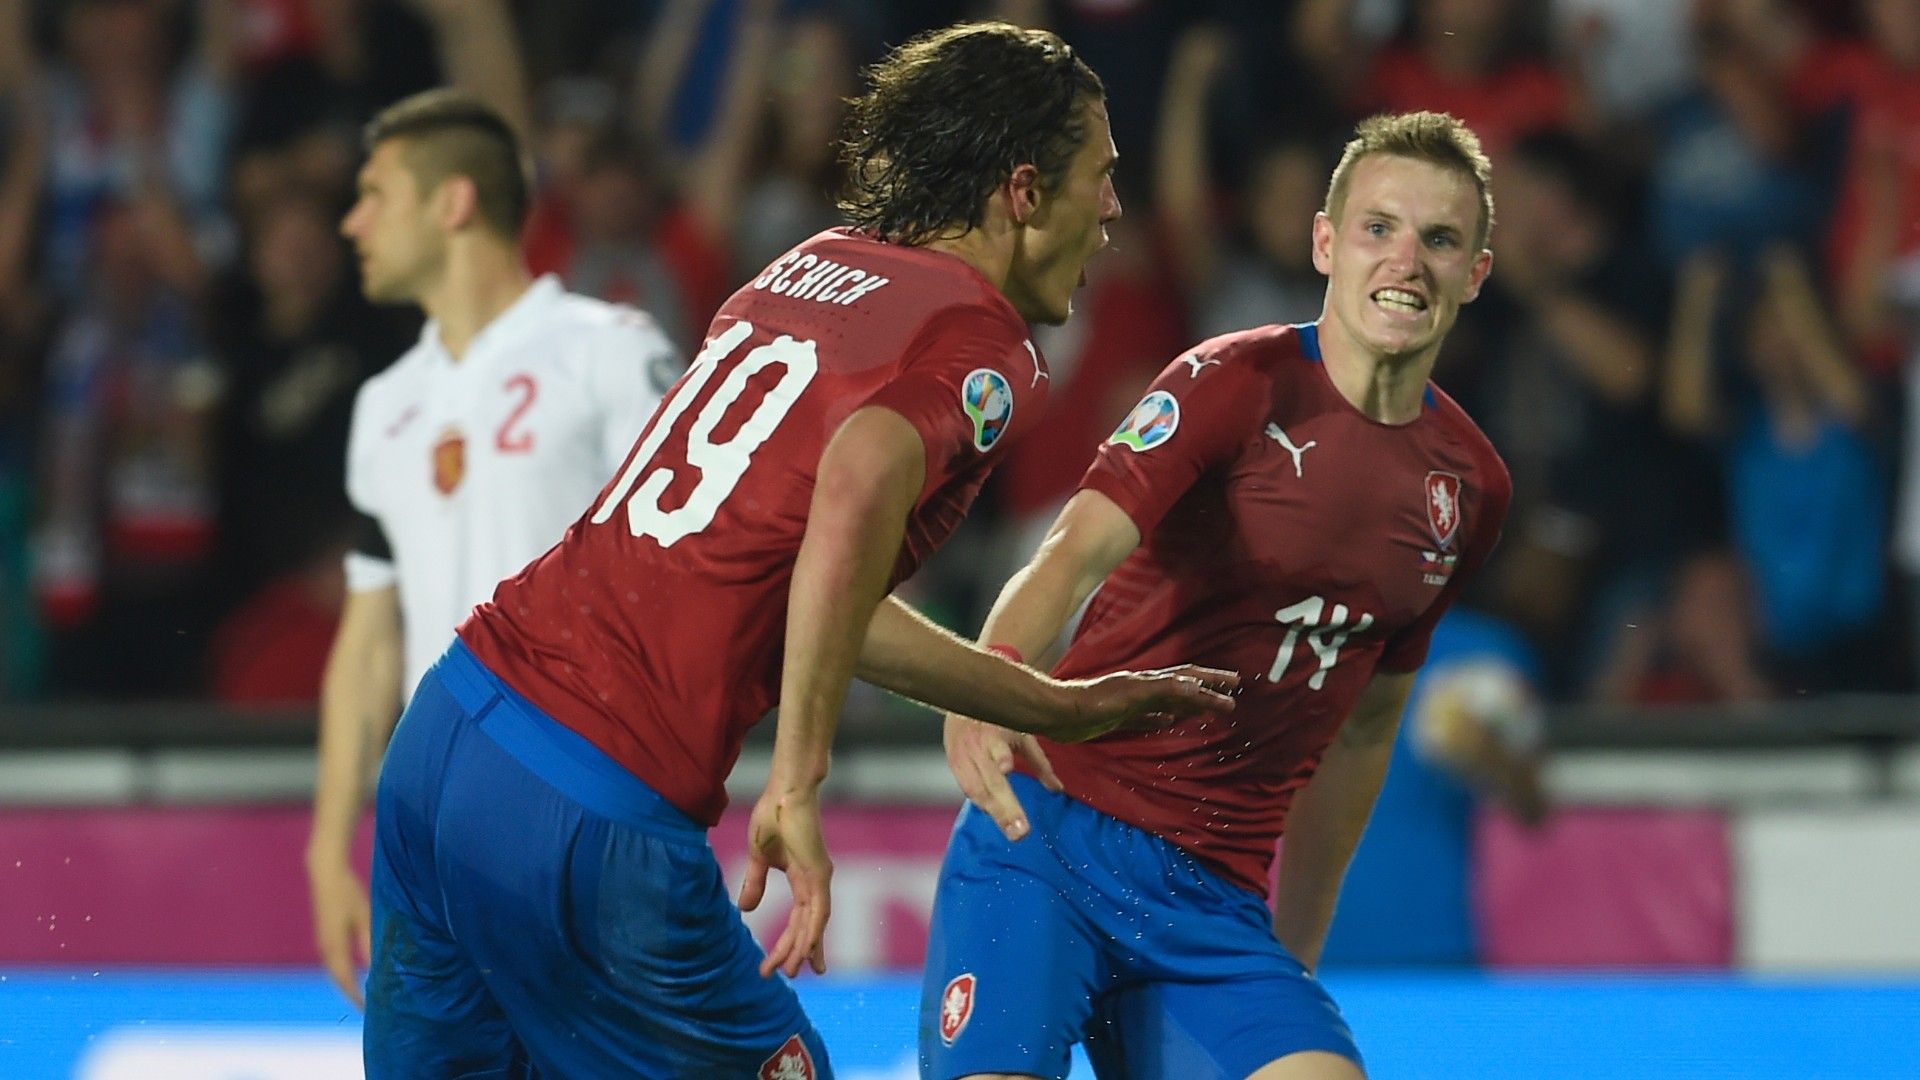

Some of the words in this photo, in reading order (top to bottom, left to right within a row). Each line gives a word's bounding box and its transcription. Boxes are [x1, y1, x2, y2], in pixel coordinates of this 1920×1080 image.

[754, 251, 889, 305] SCHICK
[494, 374, 538, 455] 2
[591, 321, 817, 548] 19
[1268, 595, 1374, 691] 14
